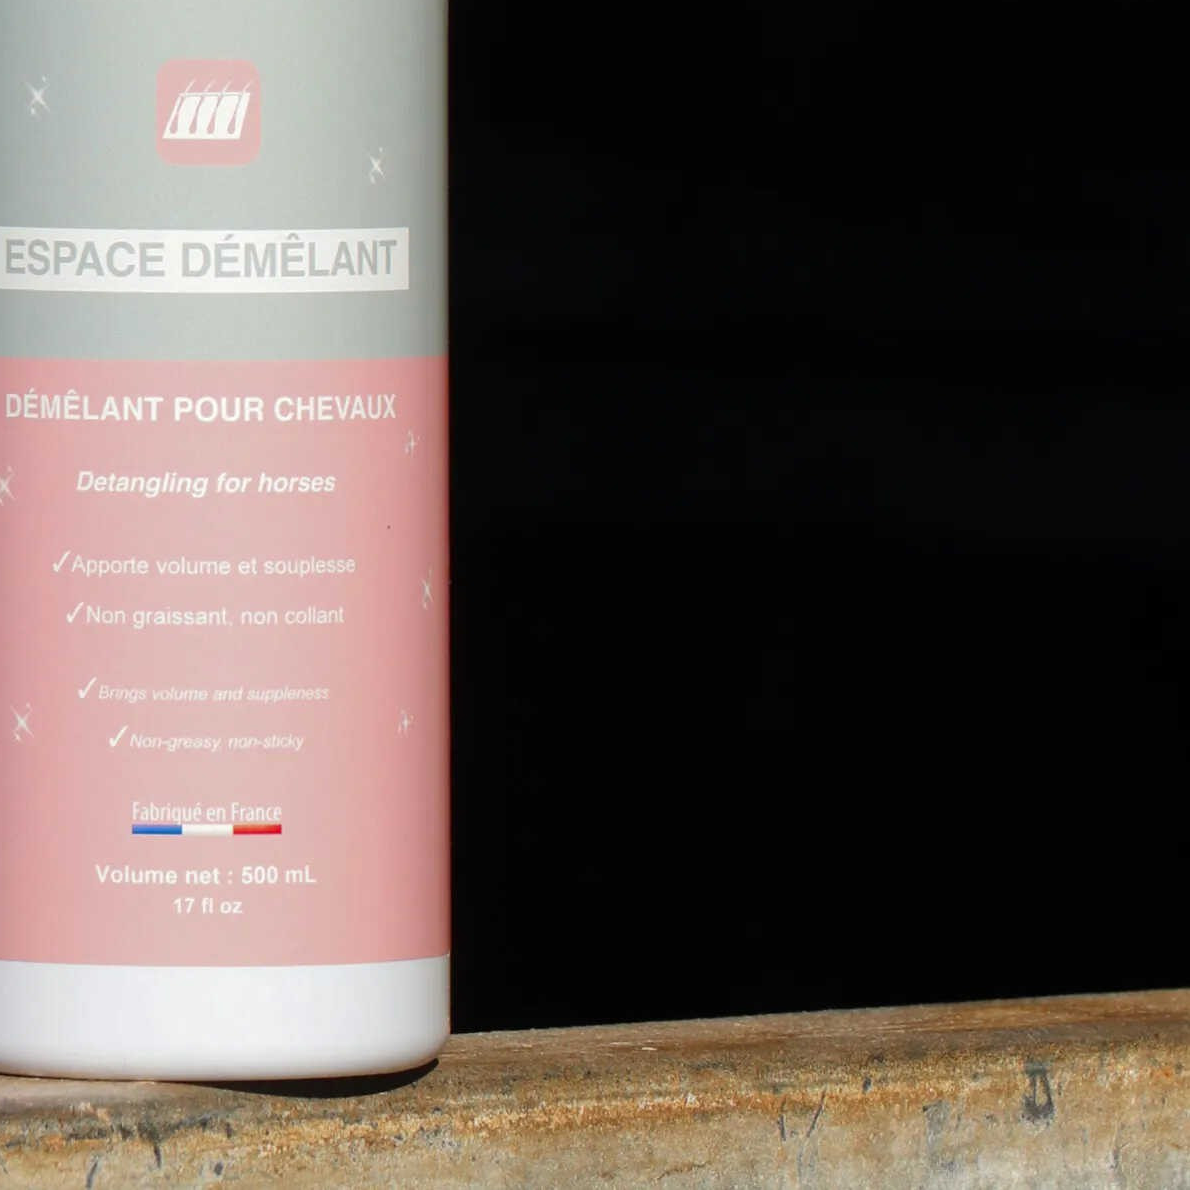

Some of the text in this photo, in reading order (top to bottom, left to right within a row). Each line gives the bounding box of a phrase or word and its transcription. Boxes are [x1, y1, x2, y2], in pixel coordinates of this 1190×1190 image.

[4, 232, 398, 279] ESPACE DÉMÊLANT
[5, 388, 397, 423] DÉMÊLANT POUR CHEVAUX
[76, 470, 337, 499] Detangling for horses
[70, 554, 356, 578] Apporte volume et souplesse
[85, 605, 346, 630] Non graissant, non collant
[98, 686, 331, 705] Brings volume and suppleness
[226, 733, 306, 753] non-sticky
[131, 801, 283, 824] Fabriqué en France
[94, 864, 179, 885] Volume
[185, 865, 220, 885] net
[241, 865, 278, 885] 500
[283, 864, 318, 884] mL
[172, 897, 243, 915] 17 fl oz
